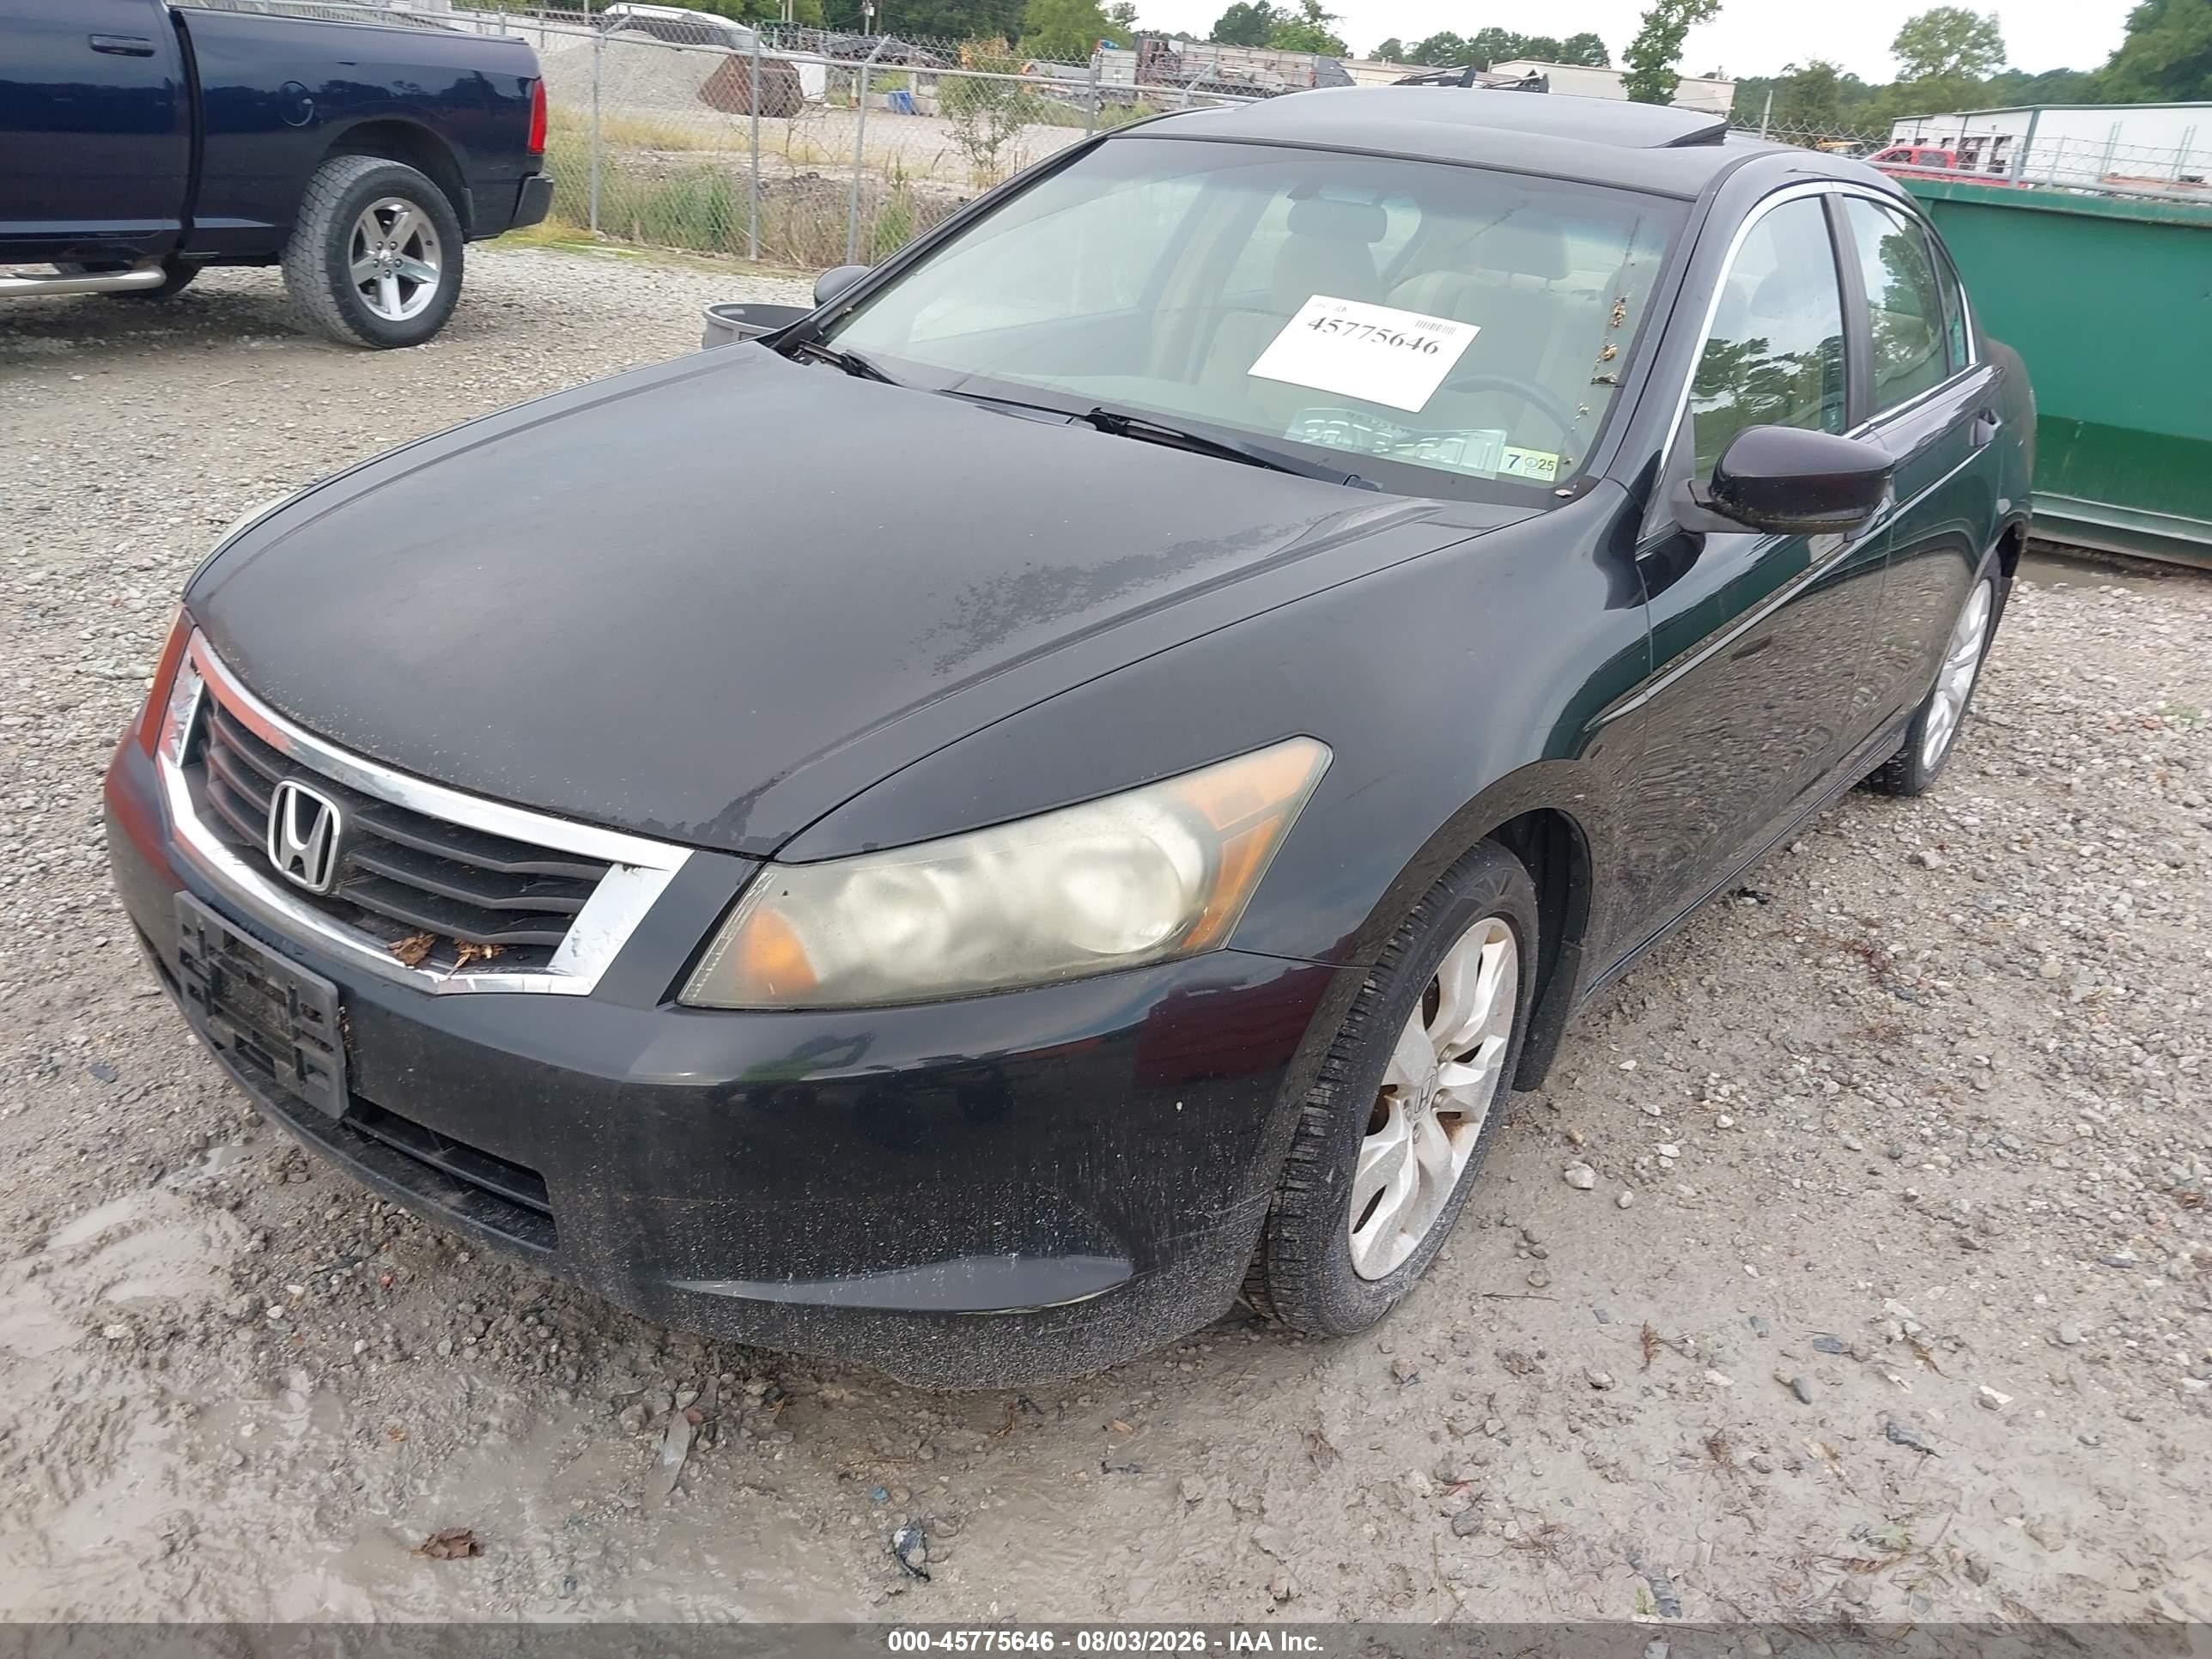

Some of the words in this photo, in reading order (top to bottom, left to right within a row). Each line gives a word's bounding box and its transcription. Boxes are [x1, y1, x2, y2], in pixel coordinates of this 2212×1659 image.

[1307, 317, 1443, 355] 45775646
[1508, 453, 1521, 469] 7
[1538, 459, 1556, 471] 25
